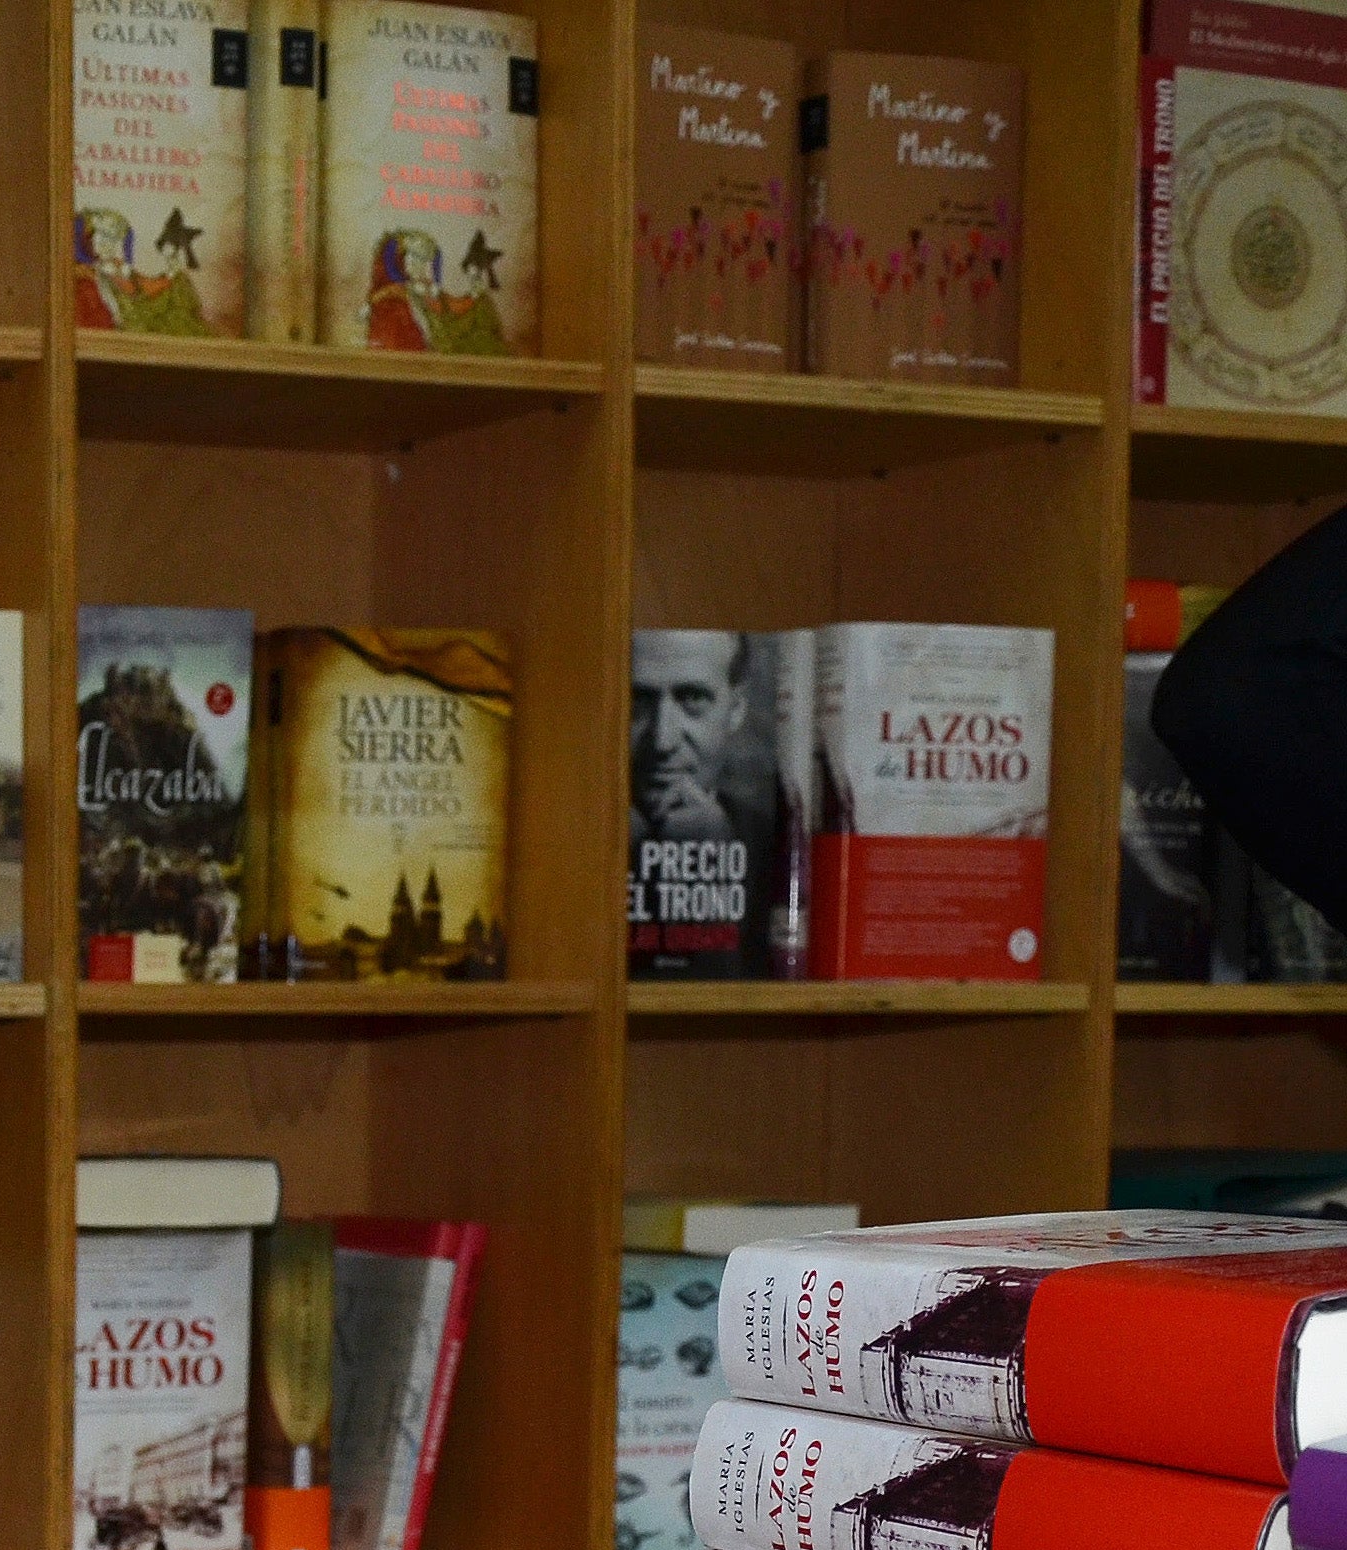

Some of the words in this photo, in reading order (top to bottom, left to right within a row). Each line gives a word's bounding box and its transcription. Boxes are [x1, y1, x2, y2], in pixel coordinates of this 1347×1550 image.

[758, 86, 781, 121] y
[1155, 79, 1175, 152] TRONO
[113, 116, 155, 139] DEL
[982, 110, 1008, 142] y
[1153, 164, 1172, 199] DEL
[1152, 207, 1171, 291] PRECIO
[1150, 302, 1169, 324] EL
[335, 694, 462, 736] JAVIER
[879, 710, 1026, 748] LAZOS
[337, 729, 464, 765] SIERRA
[905, 749, 1031, 784] HUMO
[640, 839, 747, 882] PRECIO
[657, 882, 746, 921] TRONO
[76, 1315, 216, 1352] AZOS
[743, 1289, 758, 1363] MARÍA
[761, 1276, 775, 1381] IGLESIAS
[796, 1269, 818, 1397] LAZOS
[809, 1325, 826, 1356] de
[825, 1280, 845, 1395] HUMO
[89, 1353, 225, 1390] HUMO
[718, 1442, 736, 1516] MARÍA
[734, 1431, 755, 1533] IGLESIAS
[782, 1481, 798, 1513] de
